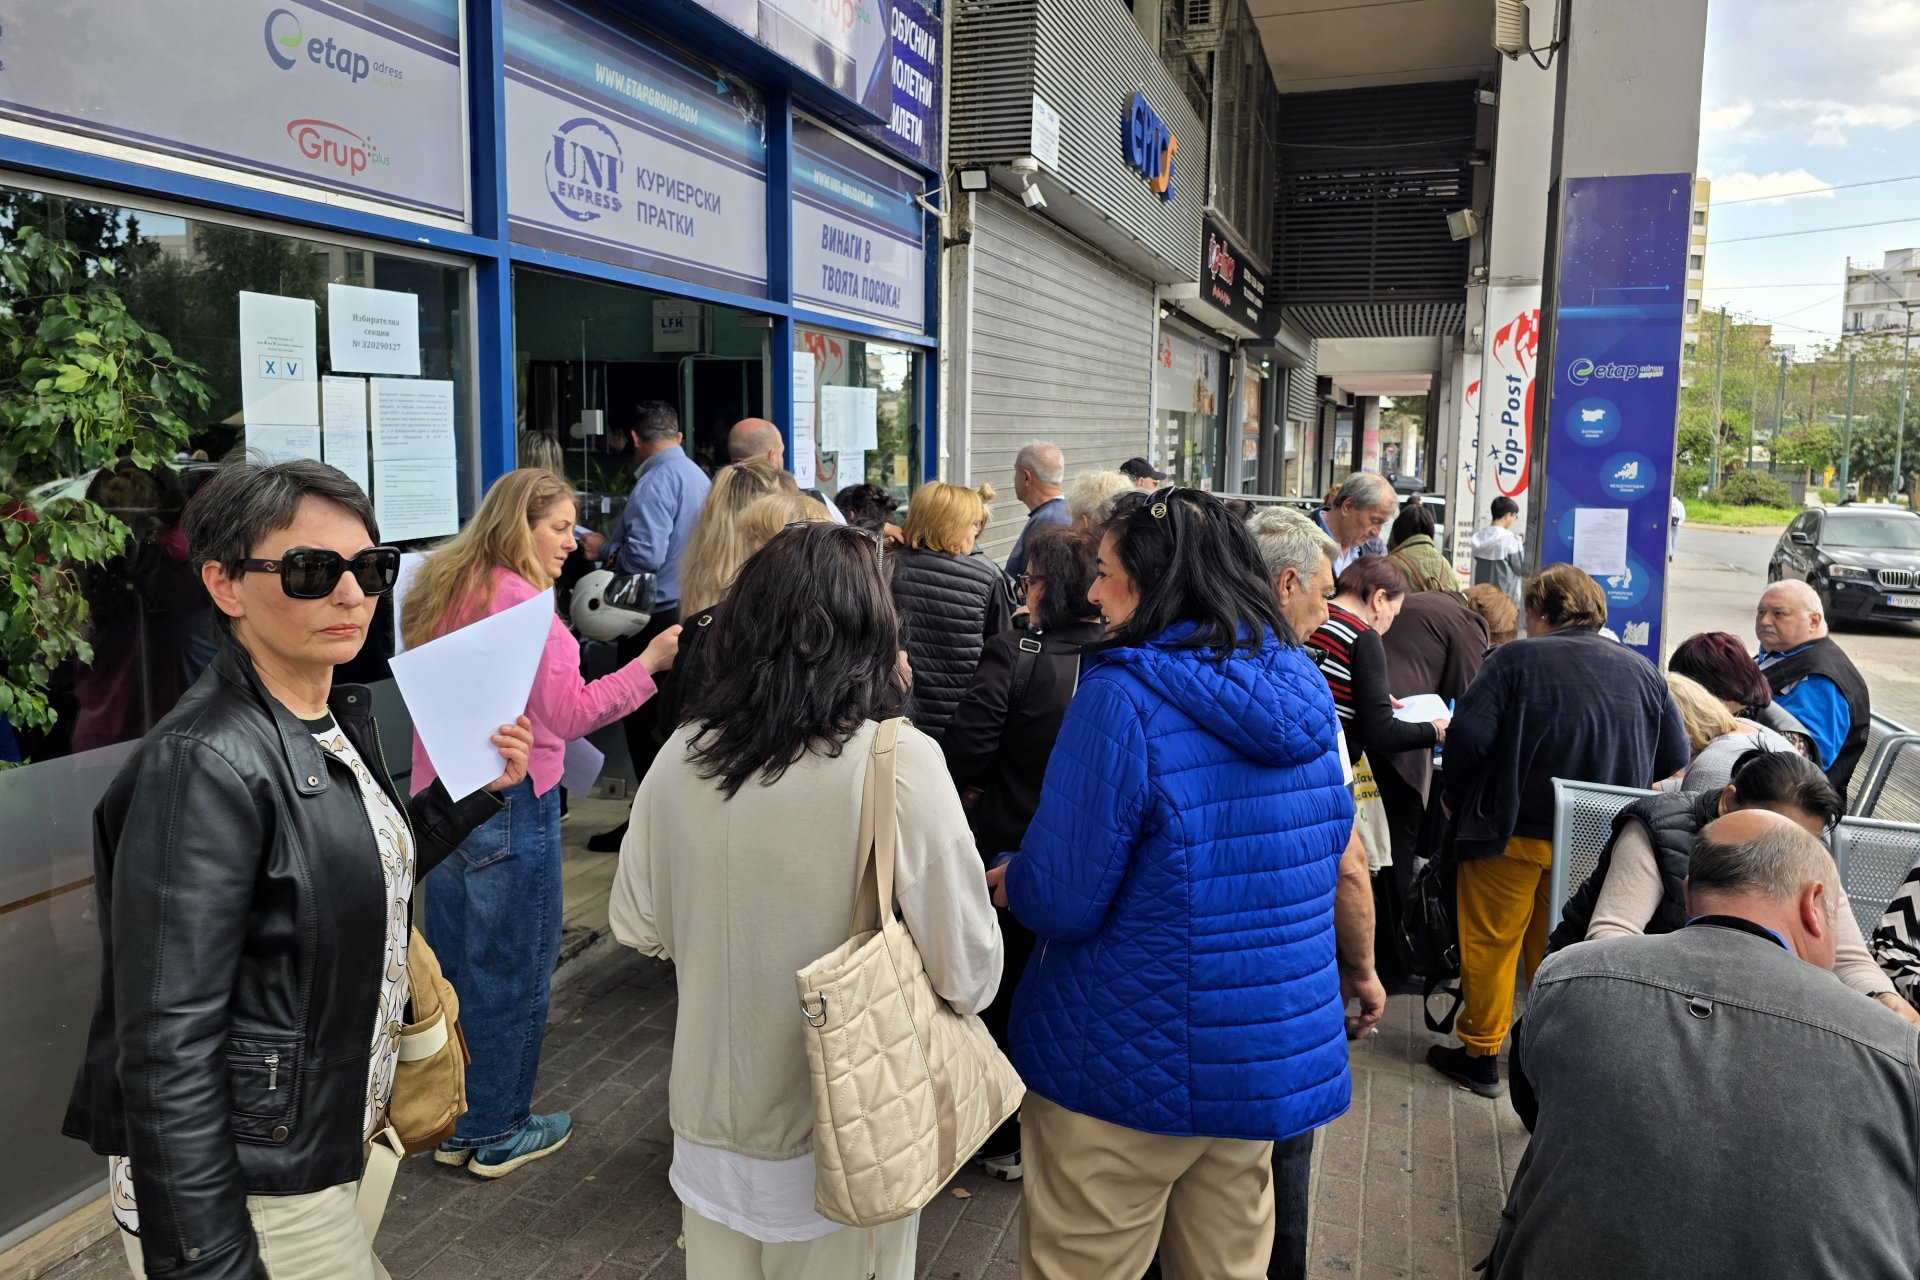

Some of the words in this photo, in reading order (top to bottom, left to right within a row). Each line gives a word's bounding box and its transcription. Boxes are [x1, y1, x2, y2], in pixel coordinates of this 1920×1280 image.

[307, 37, 370, 83] etap
[373, 61, 403, 80] adress
[595, 62, 699, 126] WWW.ETAPGROUP.COM
[885, 102, 923, 147] ИЛЕТИ
[298, 127, 367, 176] Grup
[372, 152, 390, 166] plus
[552, 134, 620, 194] UNI
[558, 180, 623, 212] EXPRESS
[636, 166, 721, 215] КУРИЕРСКИ
[637, 200, 695, 238] ПРАТКИ
[821, 224, 862, 262] ВИНАГИ
[864, 239, 871, 264] В
[822, 264, 859, 299] ТВОЯТА
[861, 276, 901, 310] ПОСОКА!
[352, 313, 400, 326] Избирателна
[364, 329, 390, 337] секция
[266, 360, 276, 375] X
[286, 362, 298, 376] V
[1594, 362, 1640, 381] etap
[1498, 374, 1524, 475] Top-Post
